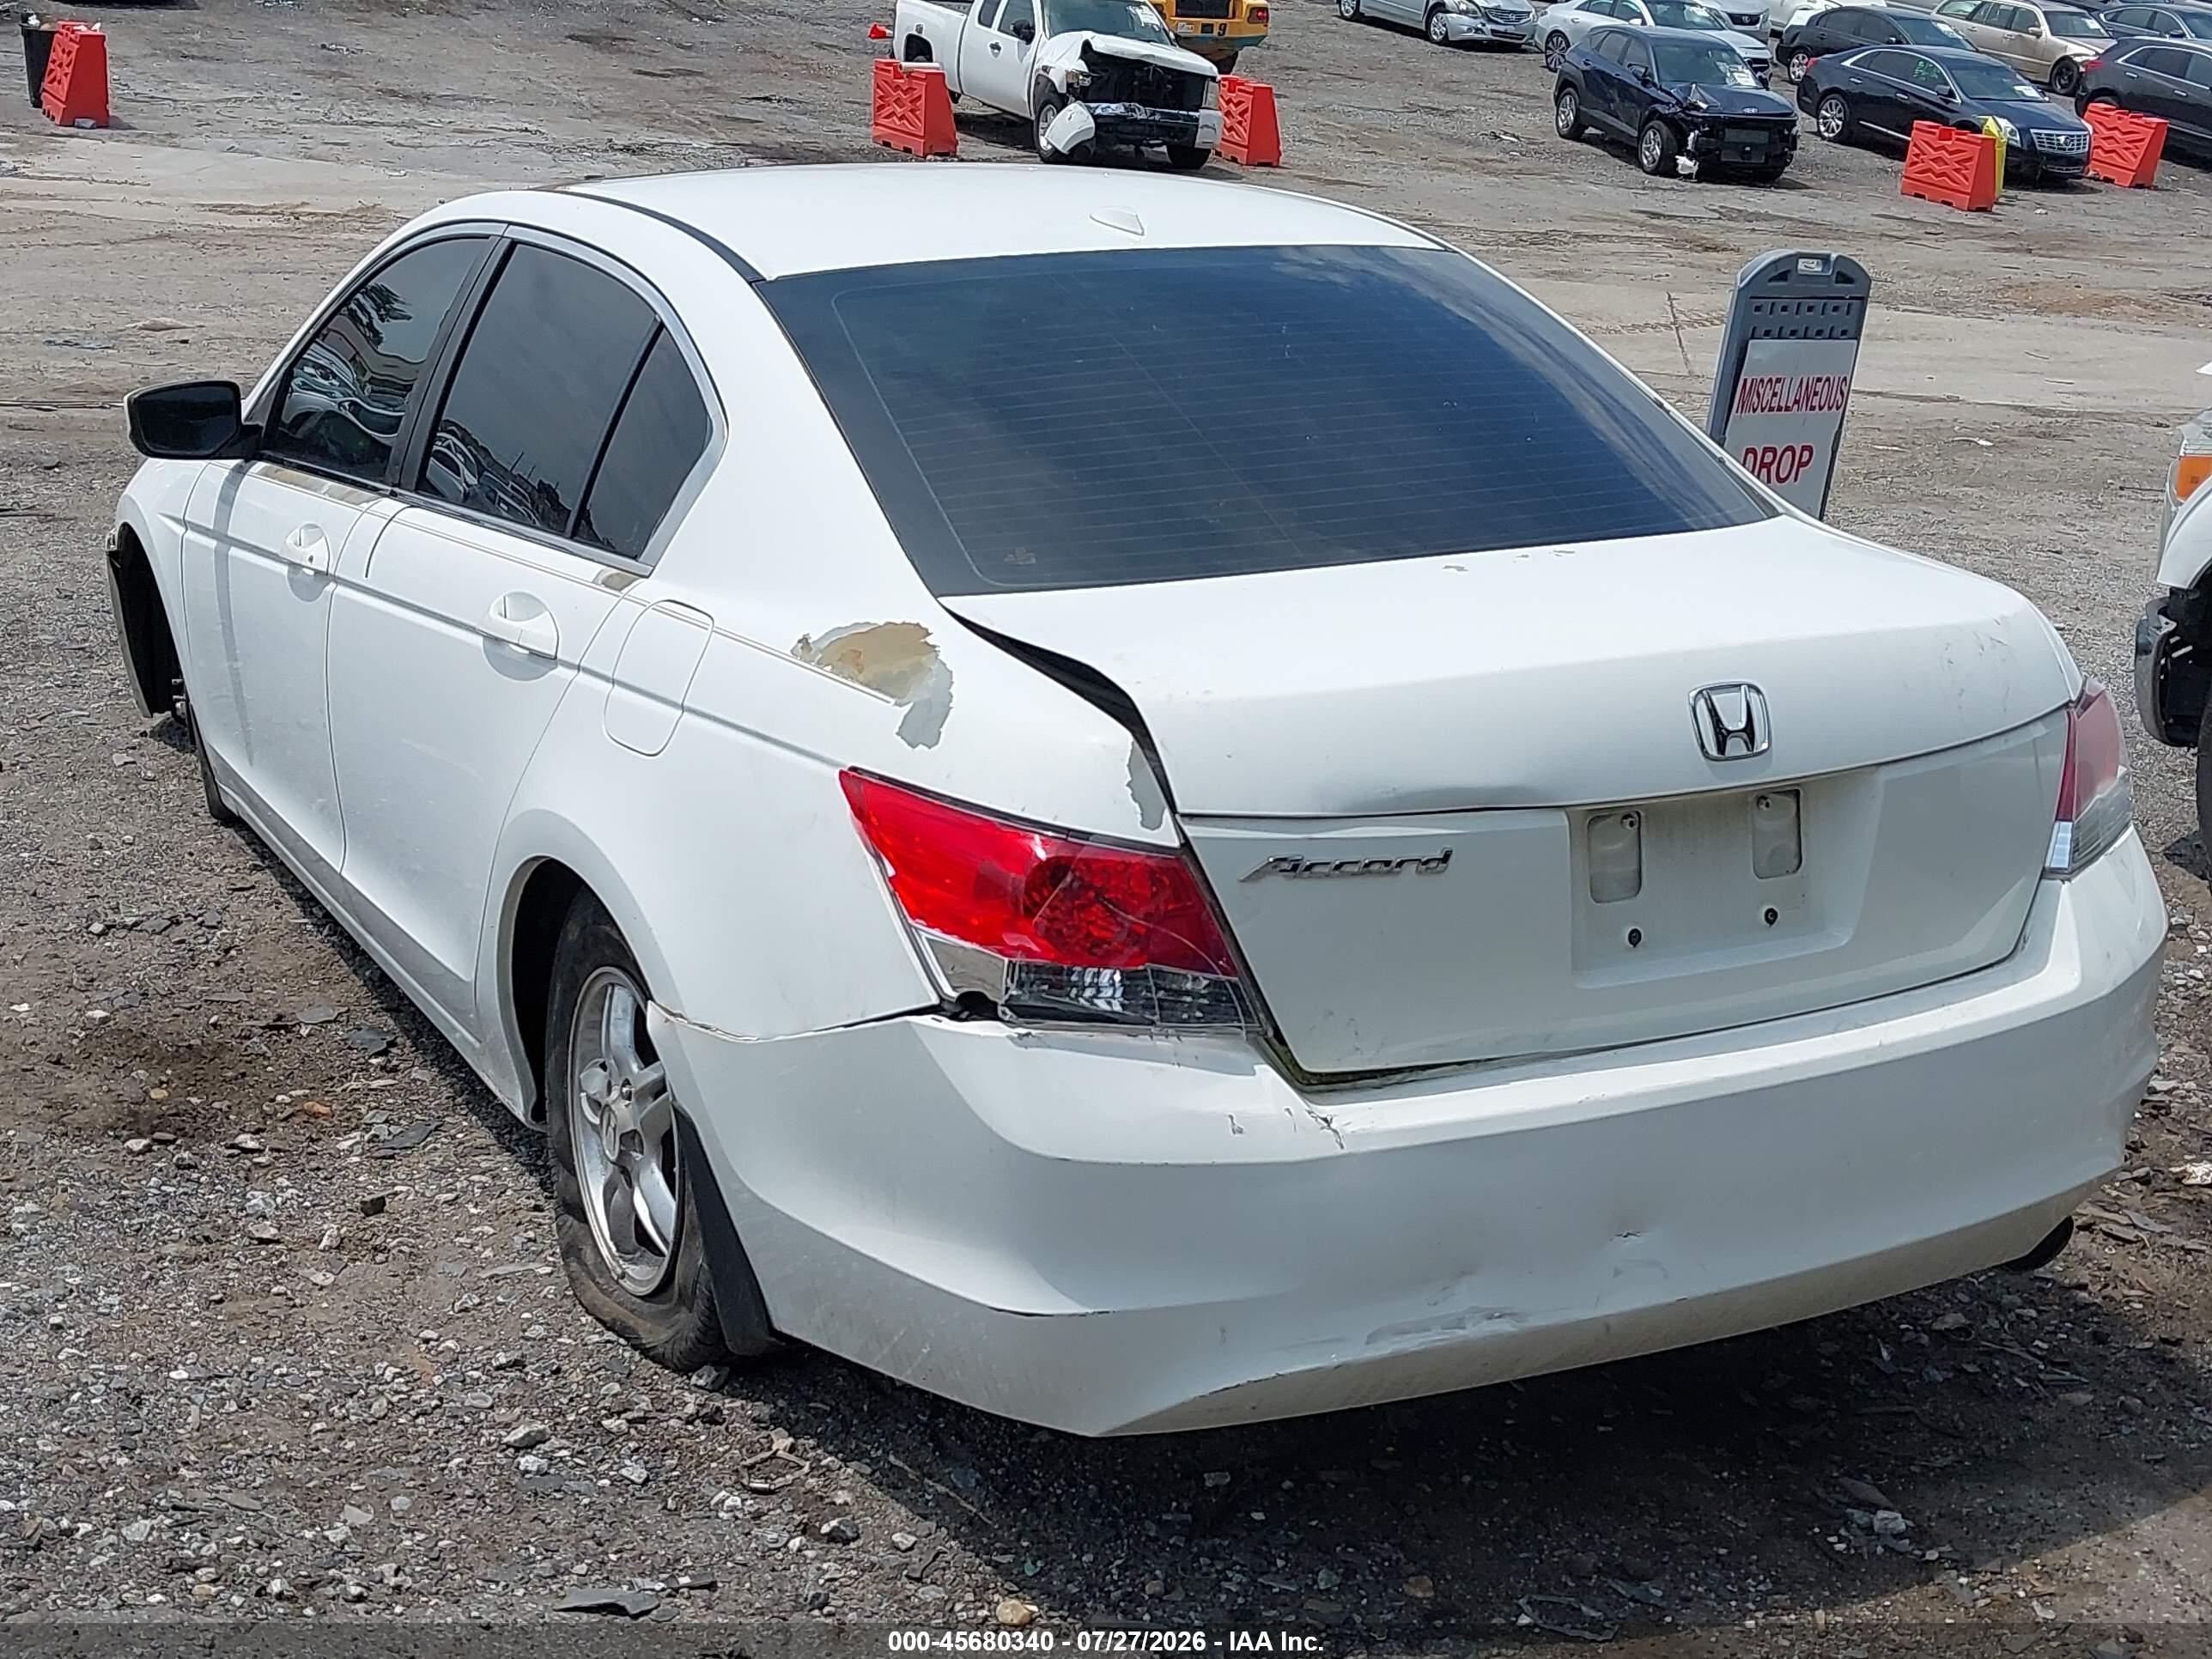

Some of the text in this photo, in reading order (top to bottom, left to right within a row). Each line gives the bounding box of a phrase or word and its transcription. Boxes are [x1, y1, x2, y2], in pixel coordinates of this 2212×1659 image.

[1735, 376, 1847, 414] MISCELLANEOUS
[1742, 445, 1814, 484] DROP
[1239, 848, 1453, 883] Accord
